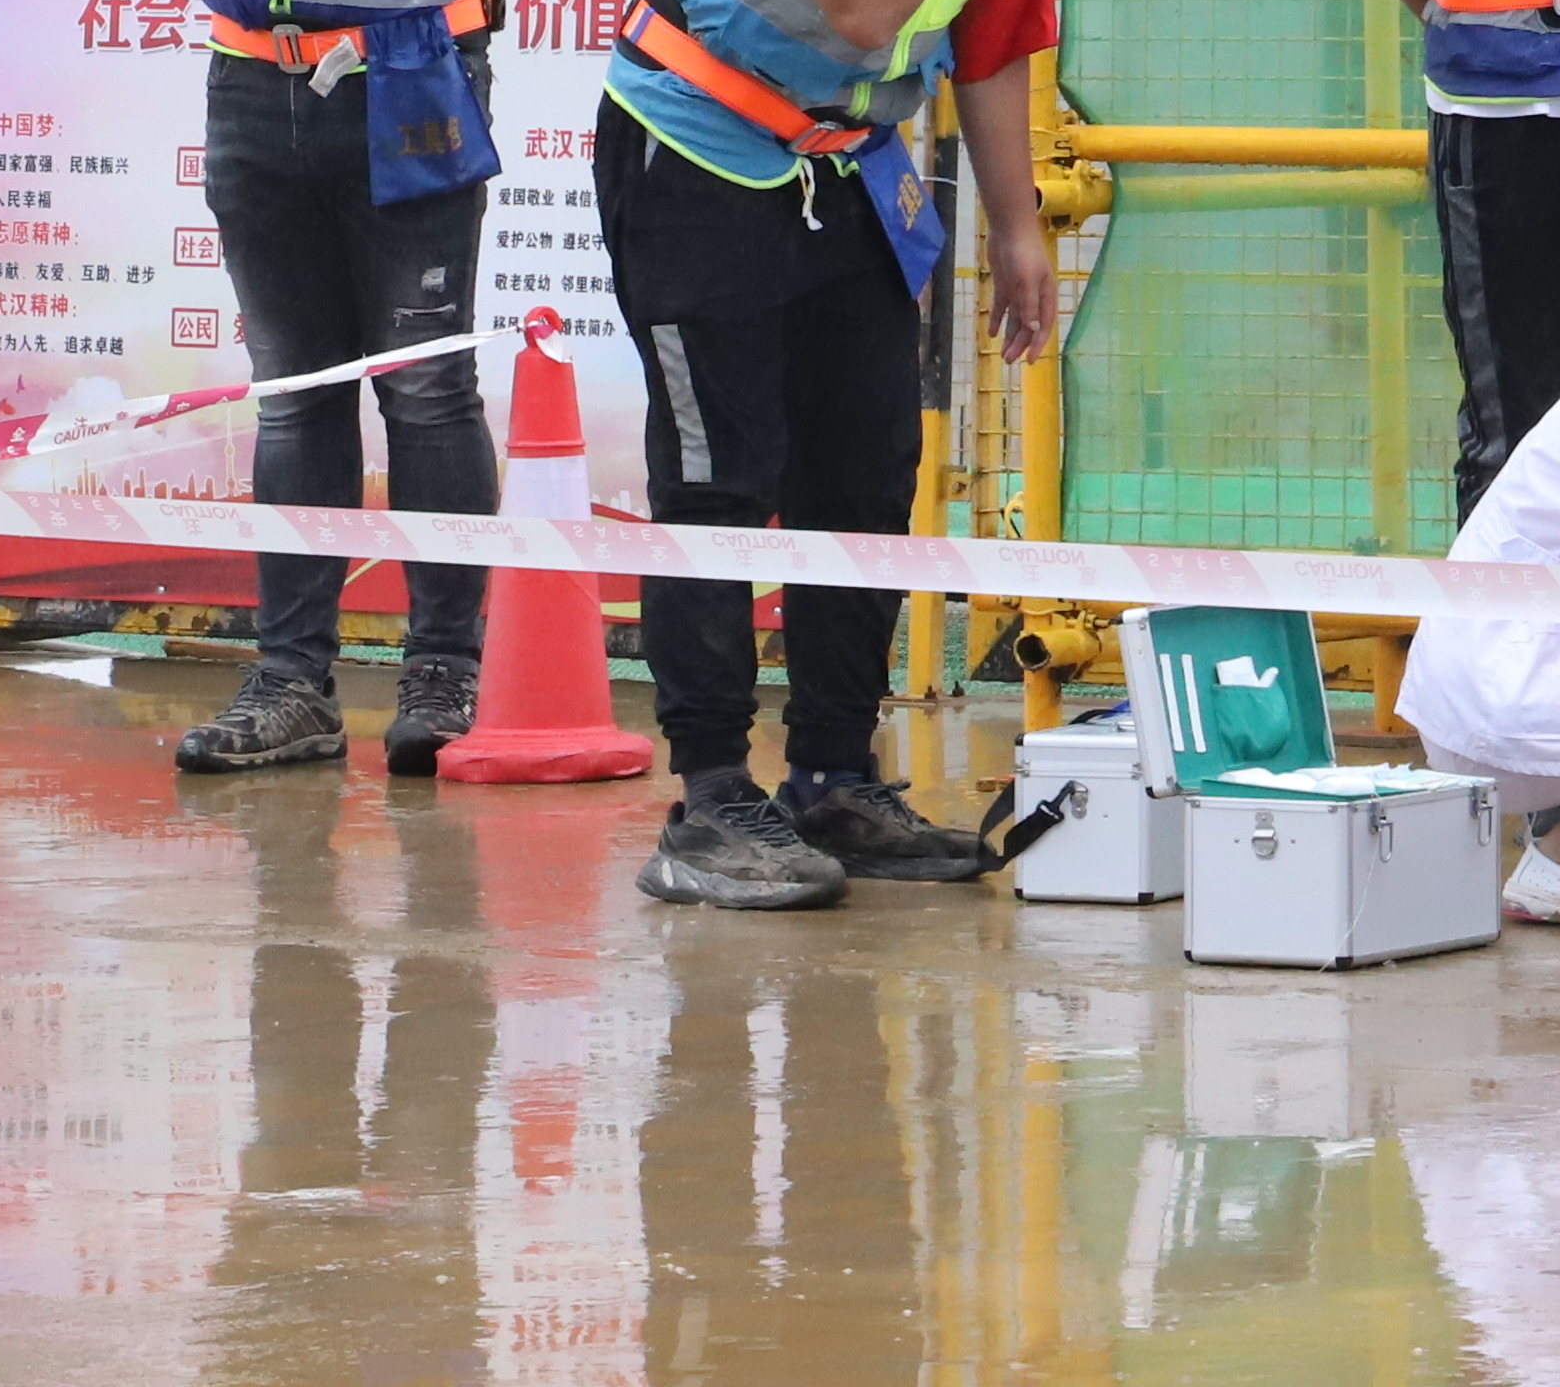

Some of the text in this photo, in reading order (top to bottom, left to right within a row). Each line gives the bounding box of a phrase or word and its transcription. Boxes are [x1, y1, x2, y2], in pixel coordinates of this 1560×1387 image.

[498, 187, 555, 206] 爱国敬业
[180, 235, 214, 260] 社会
[496, 230, 553, 250] 爱护公物
[494, 272, 616, 295] 敬老爱幼 邻里和谐
[178, 316, 212, 341] 公民
